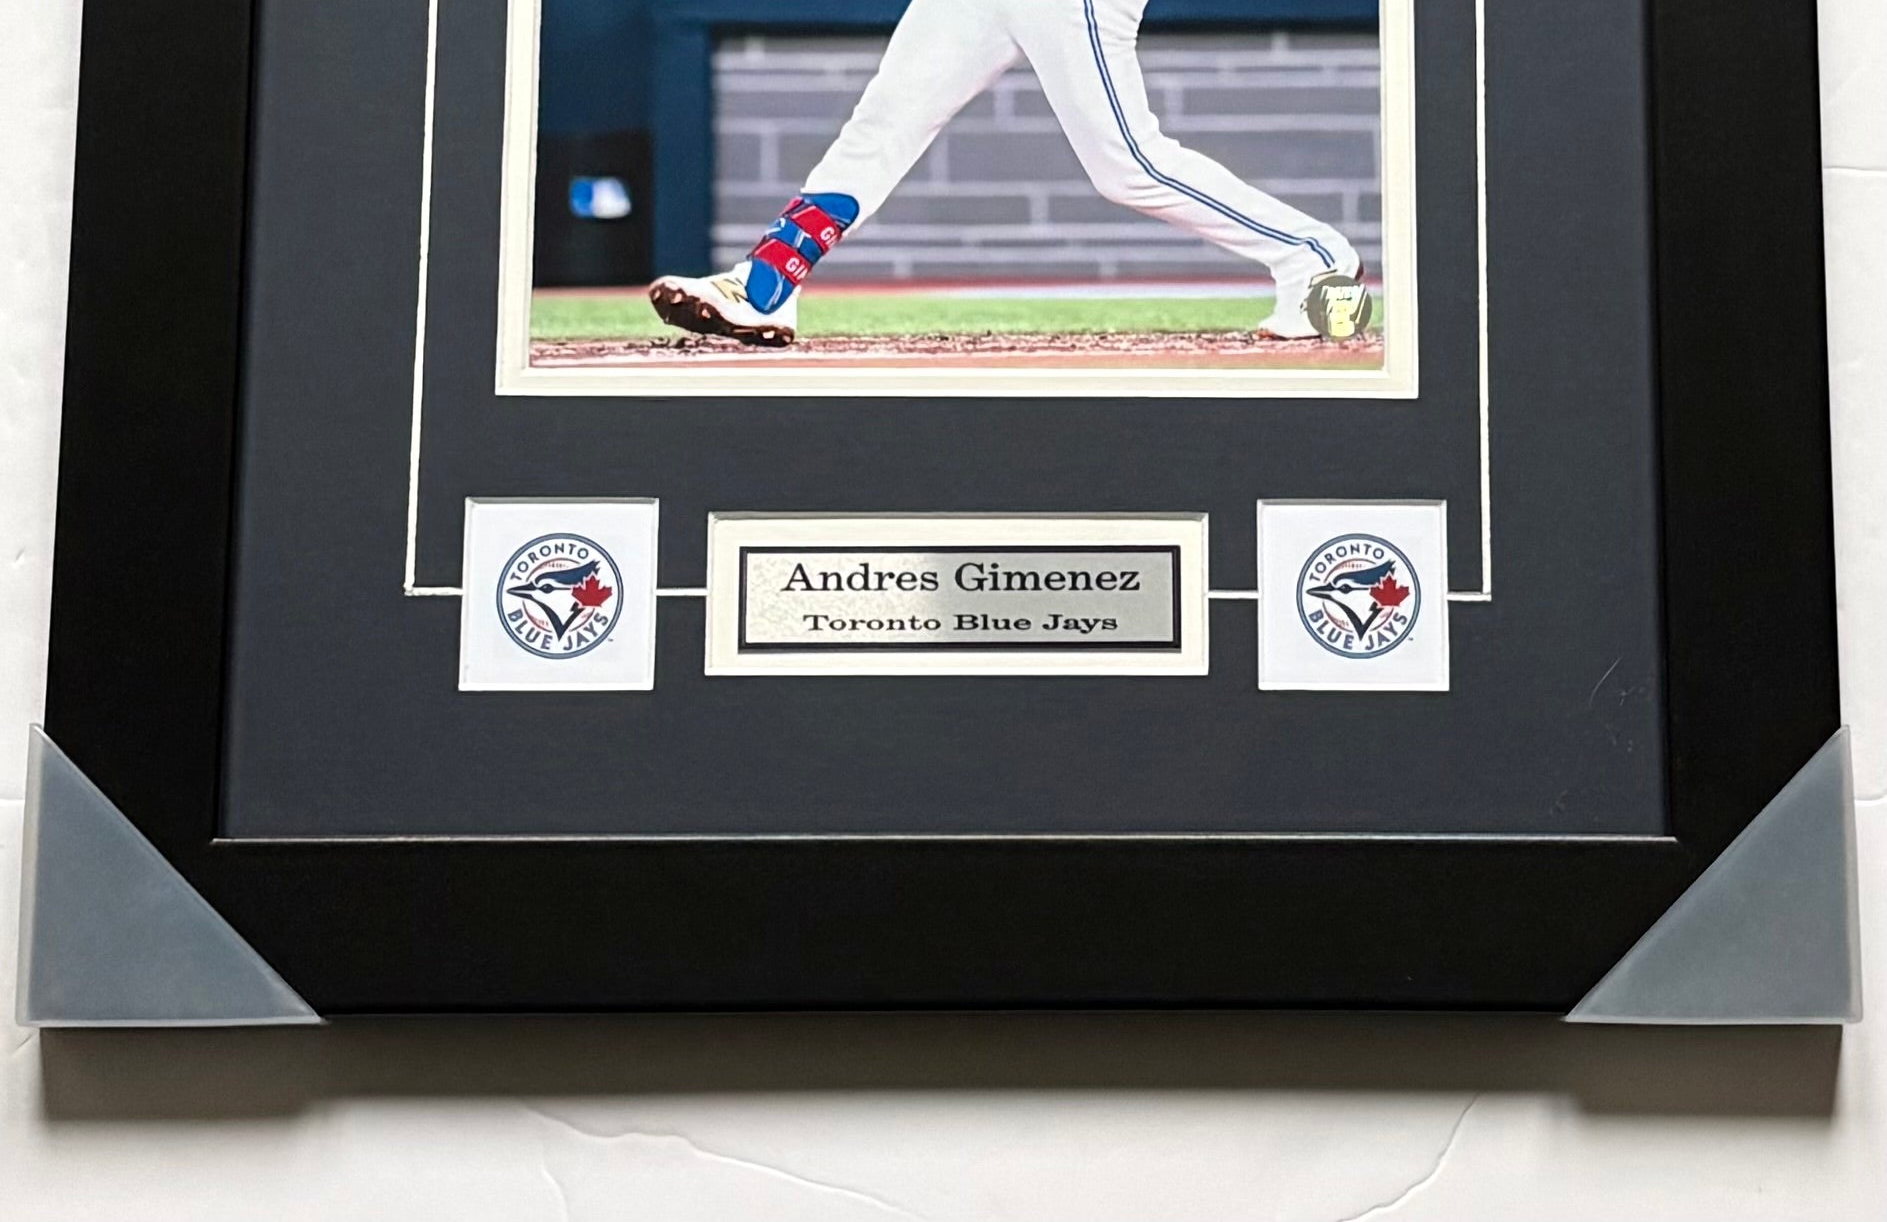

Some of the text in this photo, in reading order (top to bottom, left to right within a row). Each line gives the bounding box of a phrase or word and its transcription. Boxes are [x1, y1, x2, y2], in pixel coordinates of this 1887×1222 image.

[510, 542, 589, 582] TORONTO
[780, 562, 1141, 592] Andres Gimenez
[1308, 542, 1385, 583] TORONTO
[507, 607, 609, 651] BLUE JAYS
[802, 614, 1119, 634] Toronto Blue Jays
[1308, 608, 1408, 651] BLUE JAYS
